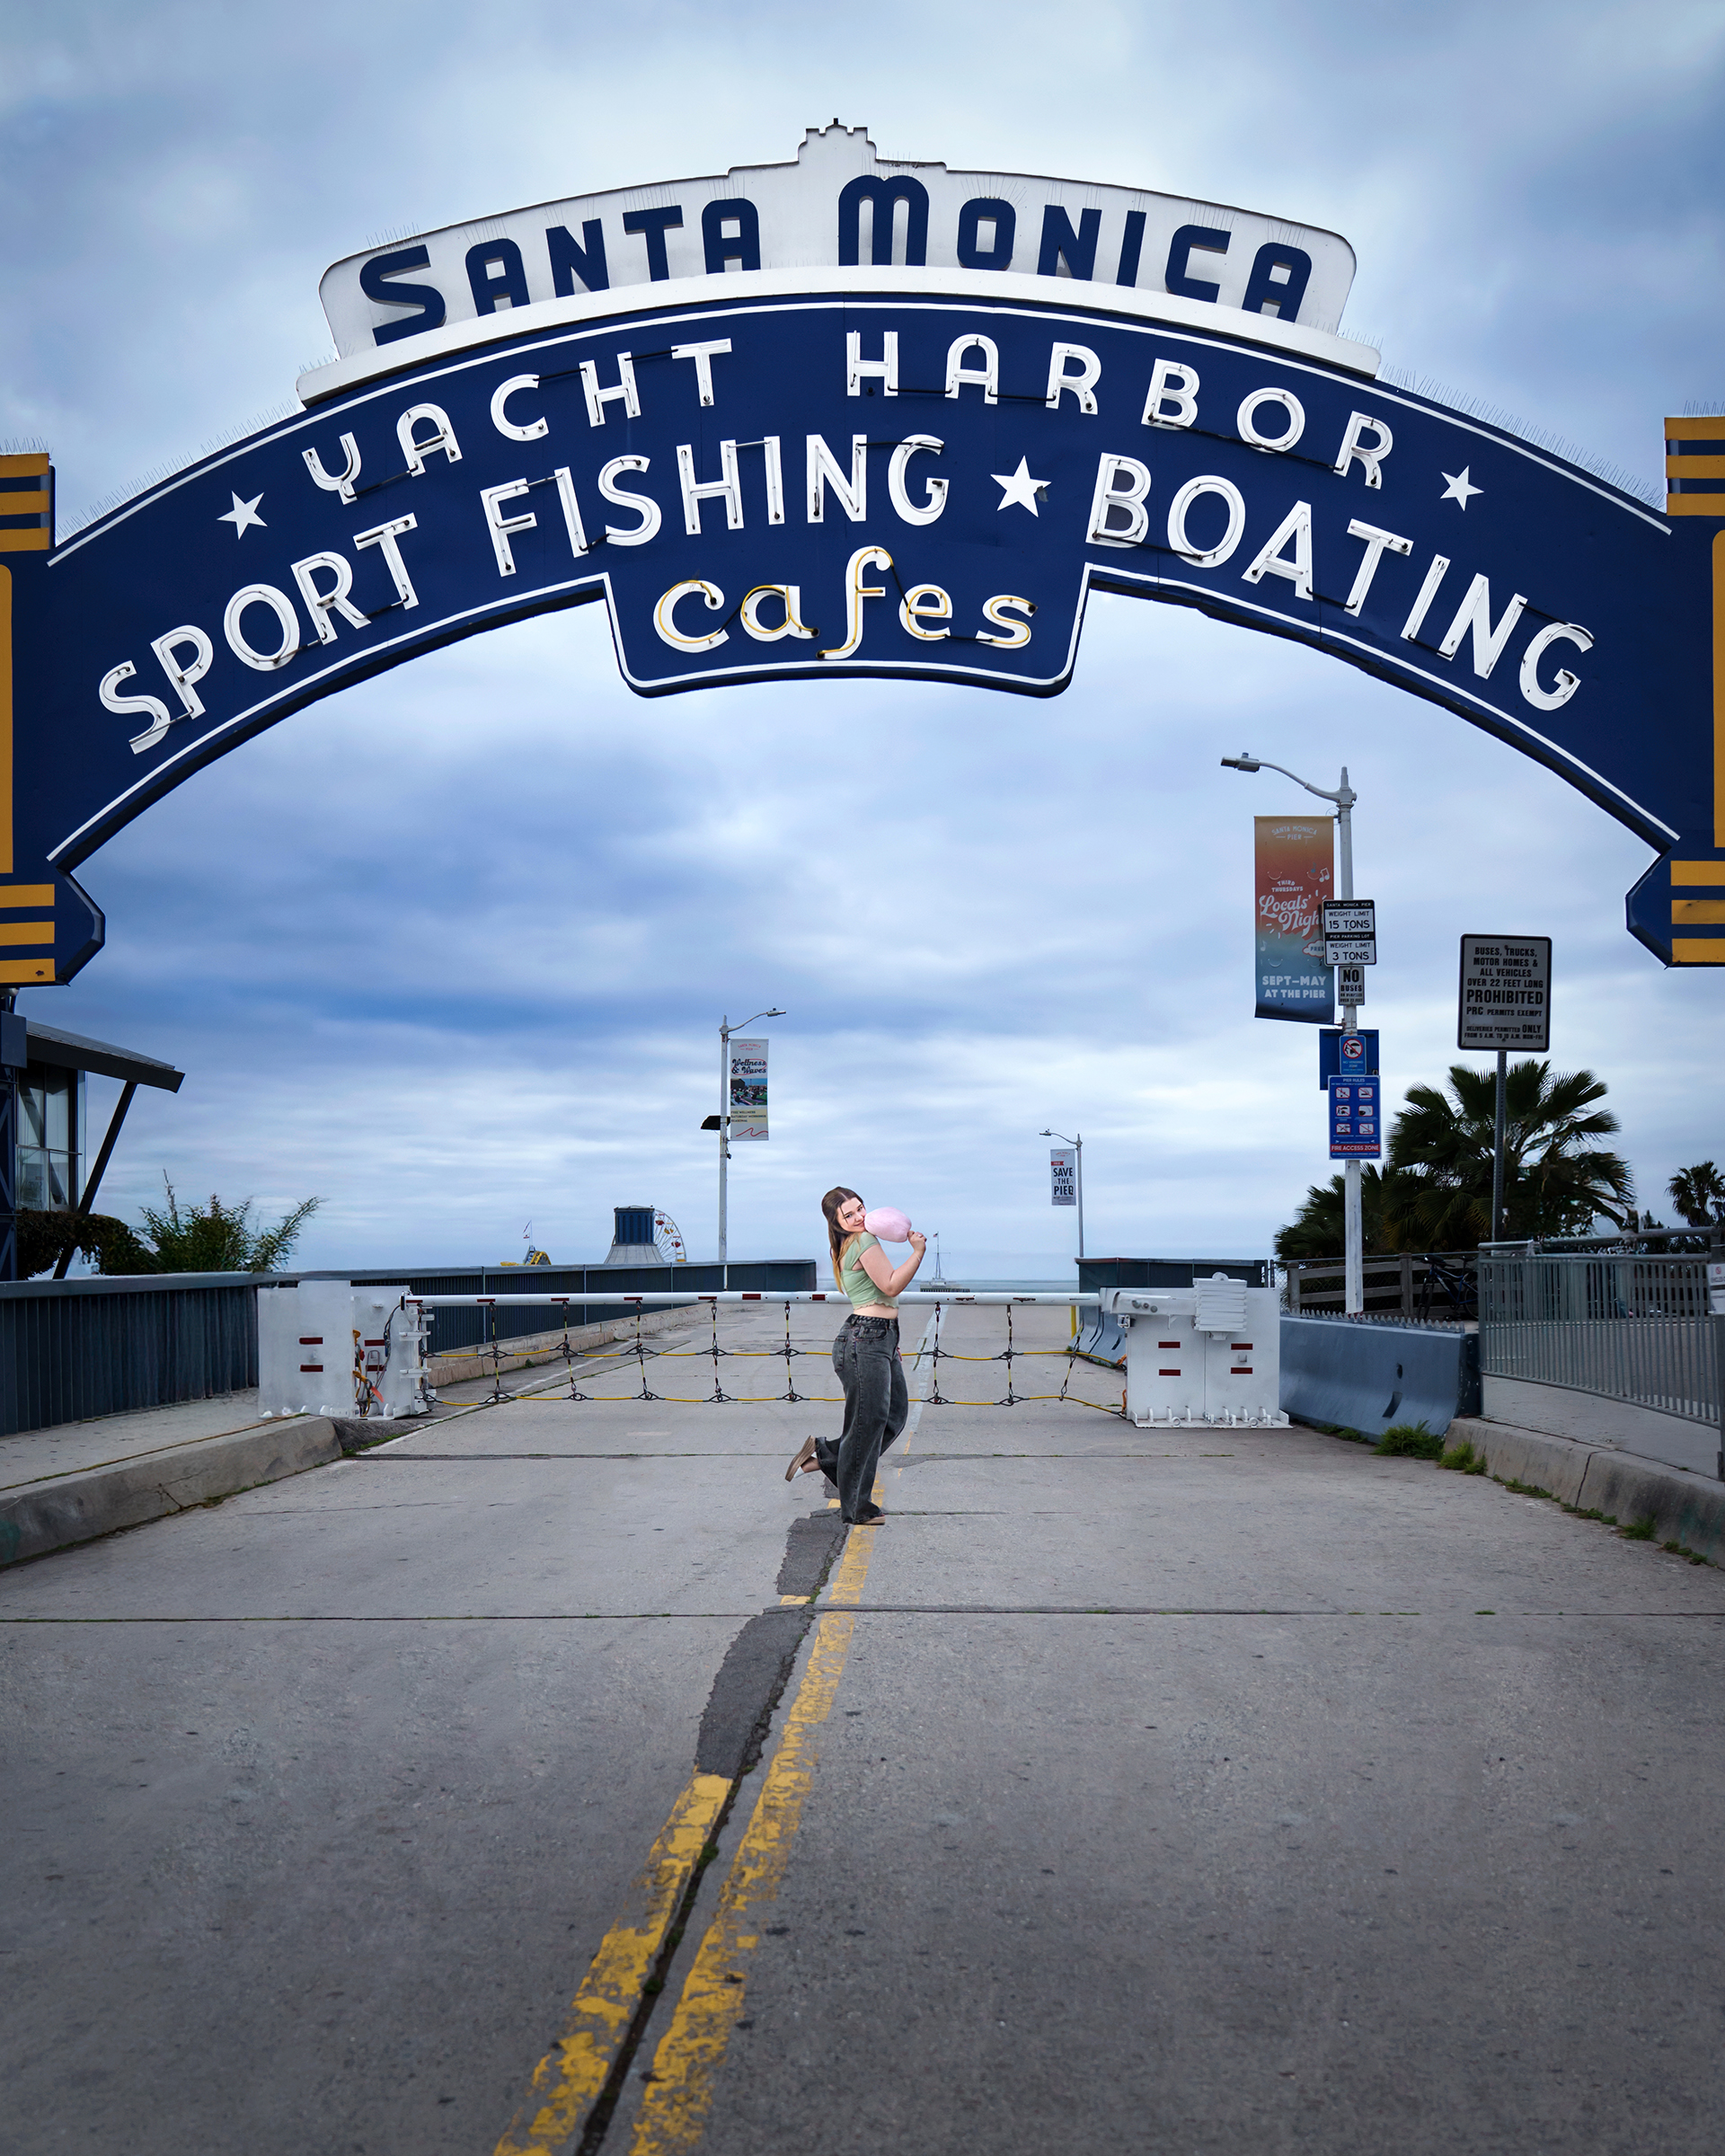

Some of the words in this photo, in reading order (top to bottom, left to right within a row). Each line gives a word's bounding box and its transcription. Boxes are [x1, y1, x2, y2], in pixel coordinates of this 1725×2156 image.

[358, 197, 761, 347] SANTA
[837, 174, 1313, 324] MONICA
[301, 337, 732, 505] YACHT
[845, 330, 1394, 490] HARBOR
[98, 512, 419, 755] SPORT
[480, 433, 951, 578] FISHING
[1085, 451, 1596, 711] BOATING
[1271, 826, 1290, 835] SANTA
[1292, 825, 1317, 835] MONICA
[1278, 909, 1324, 938] Nigh
[1329, 920, 1340, 929] 15
[1343, 920, 1370, 929] TONS
[1332, 952, 1339, 960] 3
[1342, 951, 1369, 960] TONS
[1475, 947, 1502, 957] BUSES,
[1506, 948, 1537, 958] TRUCKS,
[1473, 958, 1499, 966] MOTOR
[1533, 959, 1538, 968] &
[1343, 969, 1359, 983] NO
[1480, 968, 1493, 976] ALL
[1497, 969, 1532, 977] VEHICLES
[1467, 978, 1486, 986] OVER
[1503, 979, 1521, 987] FEET
[1524, 980, 1544, 988] LONG
[1265, 989, 1278, 998] AT
[1280, 990, 1301, 998] THE
[1303, 990, 1326, 999] PIER
[1466, 989, 1544, 1004] PROHIBITED
[1466, 1006, 1484, 1015] PRC
[1522, 1025, 1542, 1033] ONLY
[732, 1058, 766, 1066] Wellness
[742, 1066, 766, 1074] Waves
[1053, 1168, 1073, 1177] SAVE
[1054, 1186, 1074, 1196] PIER
